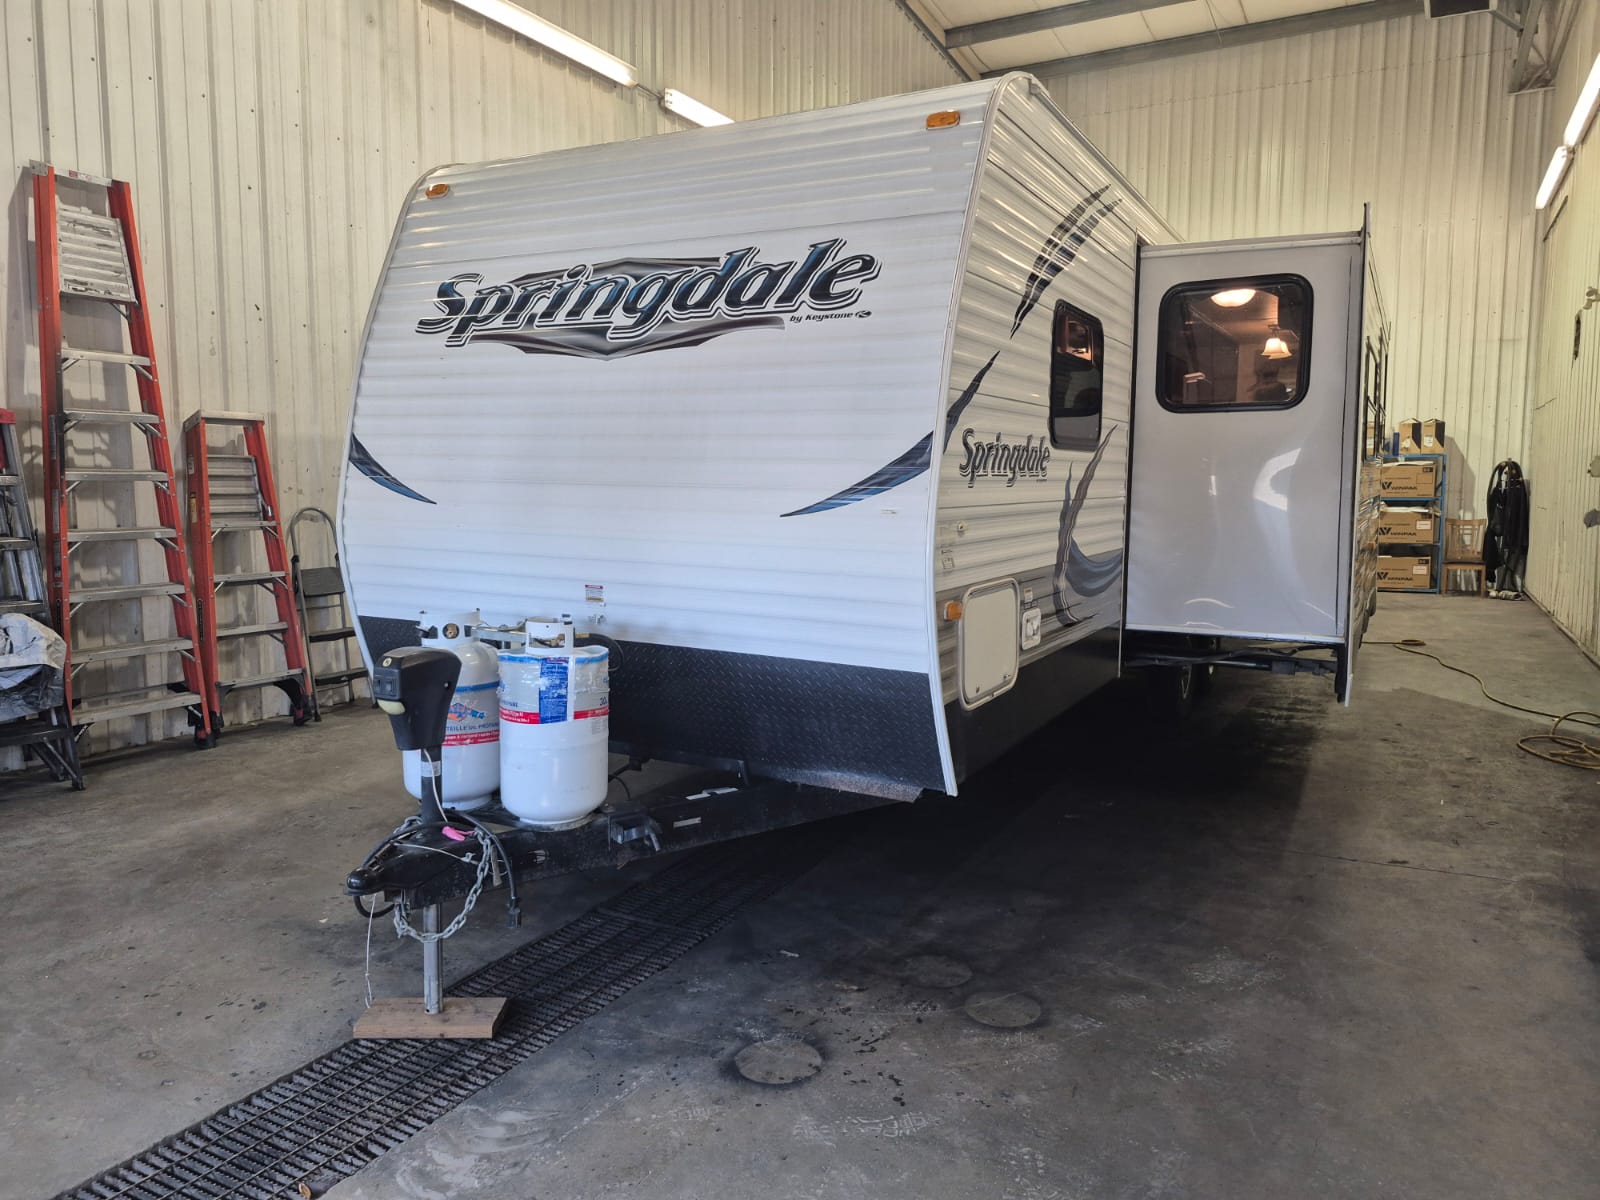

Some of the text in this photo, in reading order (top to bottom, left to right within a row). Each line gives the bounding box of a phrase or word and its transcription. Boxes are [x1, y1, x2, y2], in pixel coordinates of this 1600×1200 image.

[415, 237, 882, 347] Springdale
[789, 312, 854, 323] by Keystone
[959, 428, 1051, 489] Springdale
